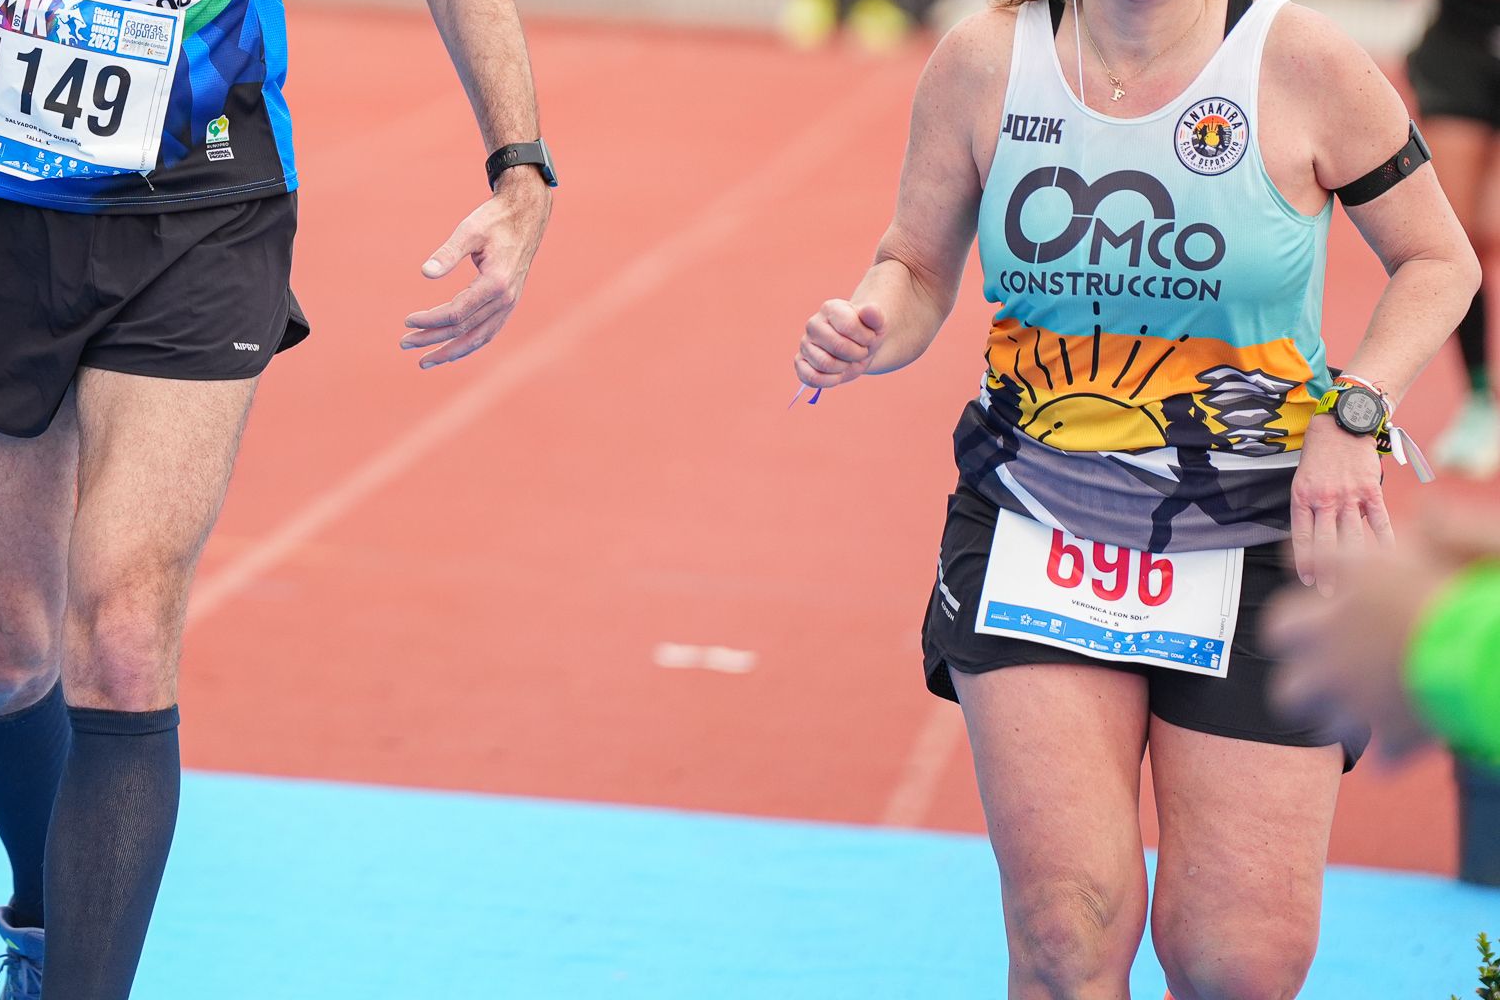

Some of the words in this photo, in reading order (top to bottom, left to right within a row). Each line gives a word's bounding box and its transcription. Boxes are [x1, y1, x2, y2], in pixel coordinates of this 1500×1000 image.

[93, 13, 120, 28] LUCENA
[125, 19, 163, 33] carreras
[88, 32, 116, 51] 2026
[124, 27, 169, 42] populares
[5, 117, 37, 130] SALVADOR
[1183, 103, 1243, 130] ANTAKIRA
[26, 134, 42, 143] TALLA
[1183, 141, 1197, 161] CLUB
[1198, 141, 1240, 167] DEPORTIVO
[1000, 271, 1222, 301] CONSTRUCCION
[1046, 528, 1174, 607] 696
[1071, 600, 1107, 613] VERONICA
[1089, 616, 1108, 624] TALLA
